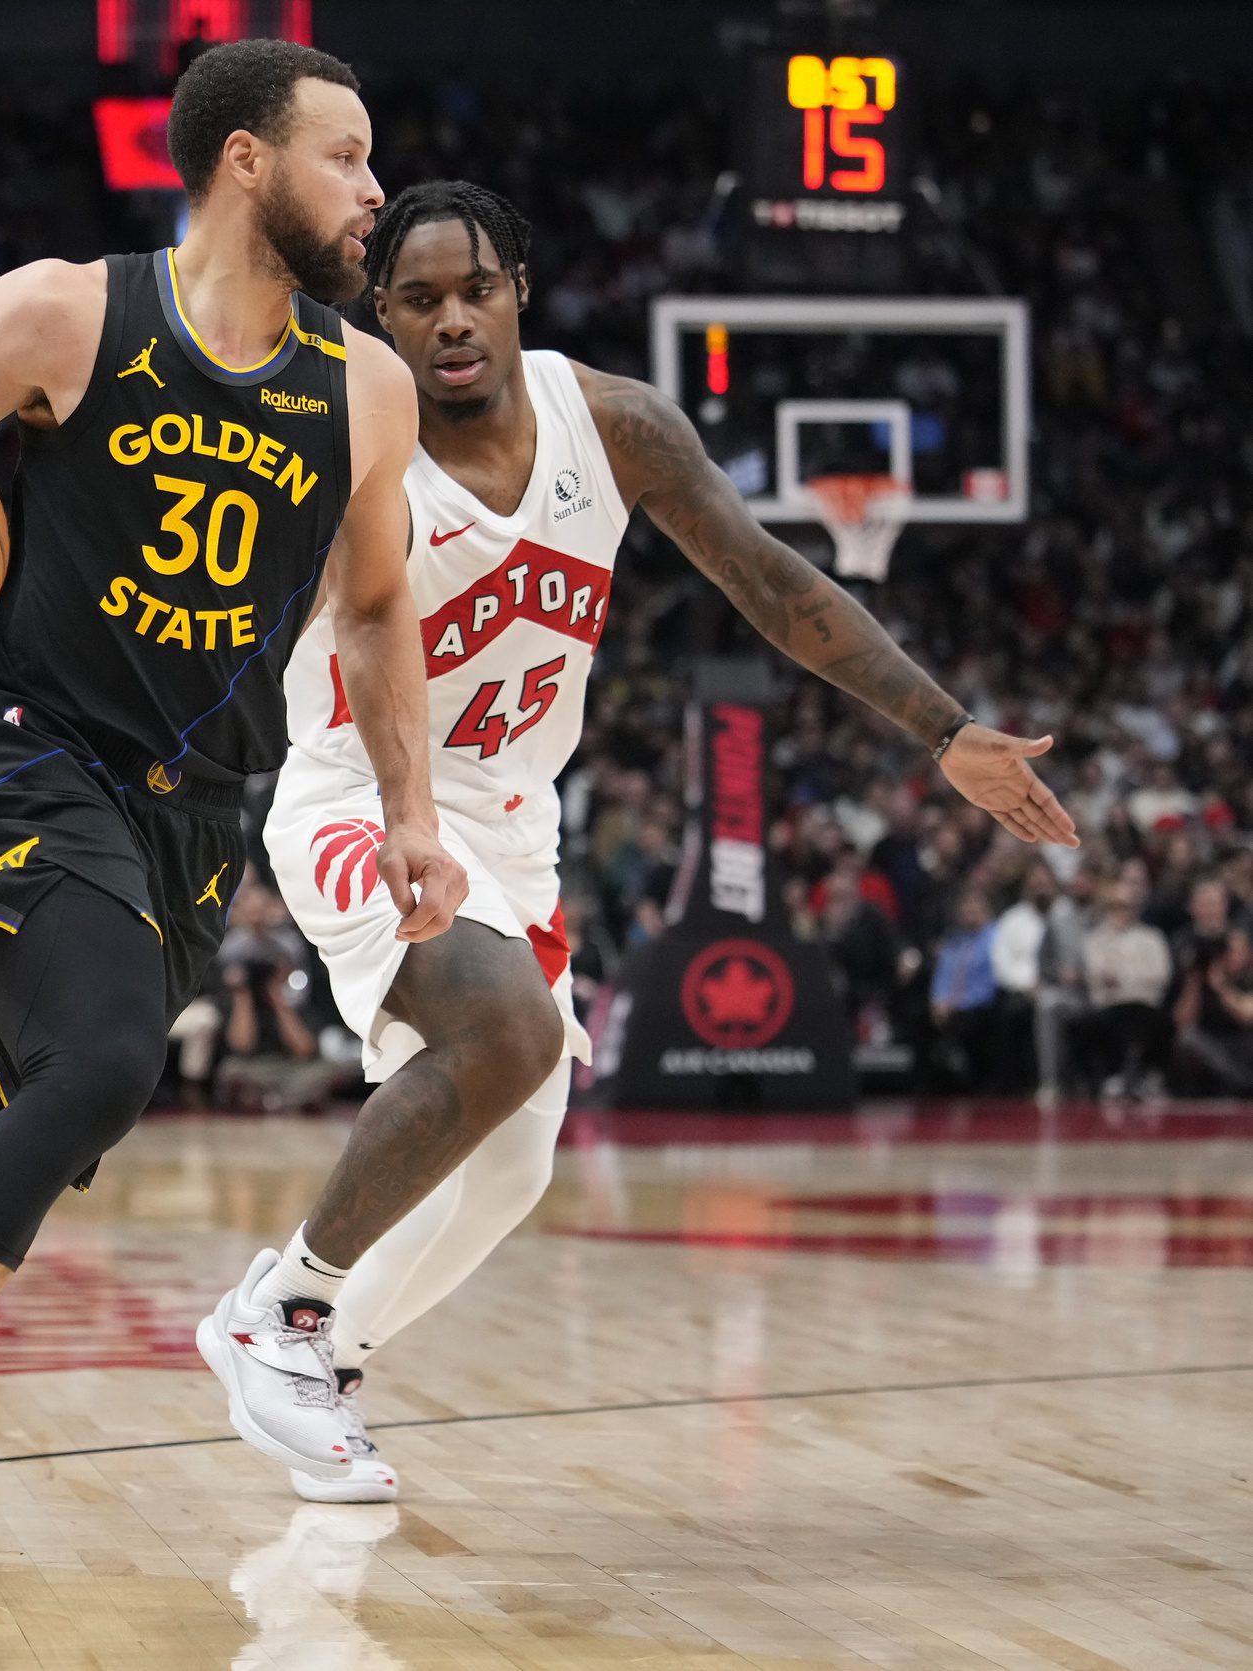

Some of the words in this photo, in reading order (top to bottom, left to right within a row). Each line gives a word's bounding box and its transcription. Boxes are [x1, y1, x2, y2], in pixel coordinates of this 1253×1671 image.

[803, 104, 885, 192] 15
[260, 388, 328, 414] Rakuten
[108, 413, 319, 506] GOLDEN
[141, 473, 260, 587] 30
[553, 508, 572, 523] Sun
[571, 496, 593, 513] Life
[99, 576, 257, 651] STATE
[431, 563, 606, 658] APTOR
[442, 654, 567, 760] 45
